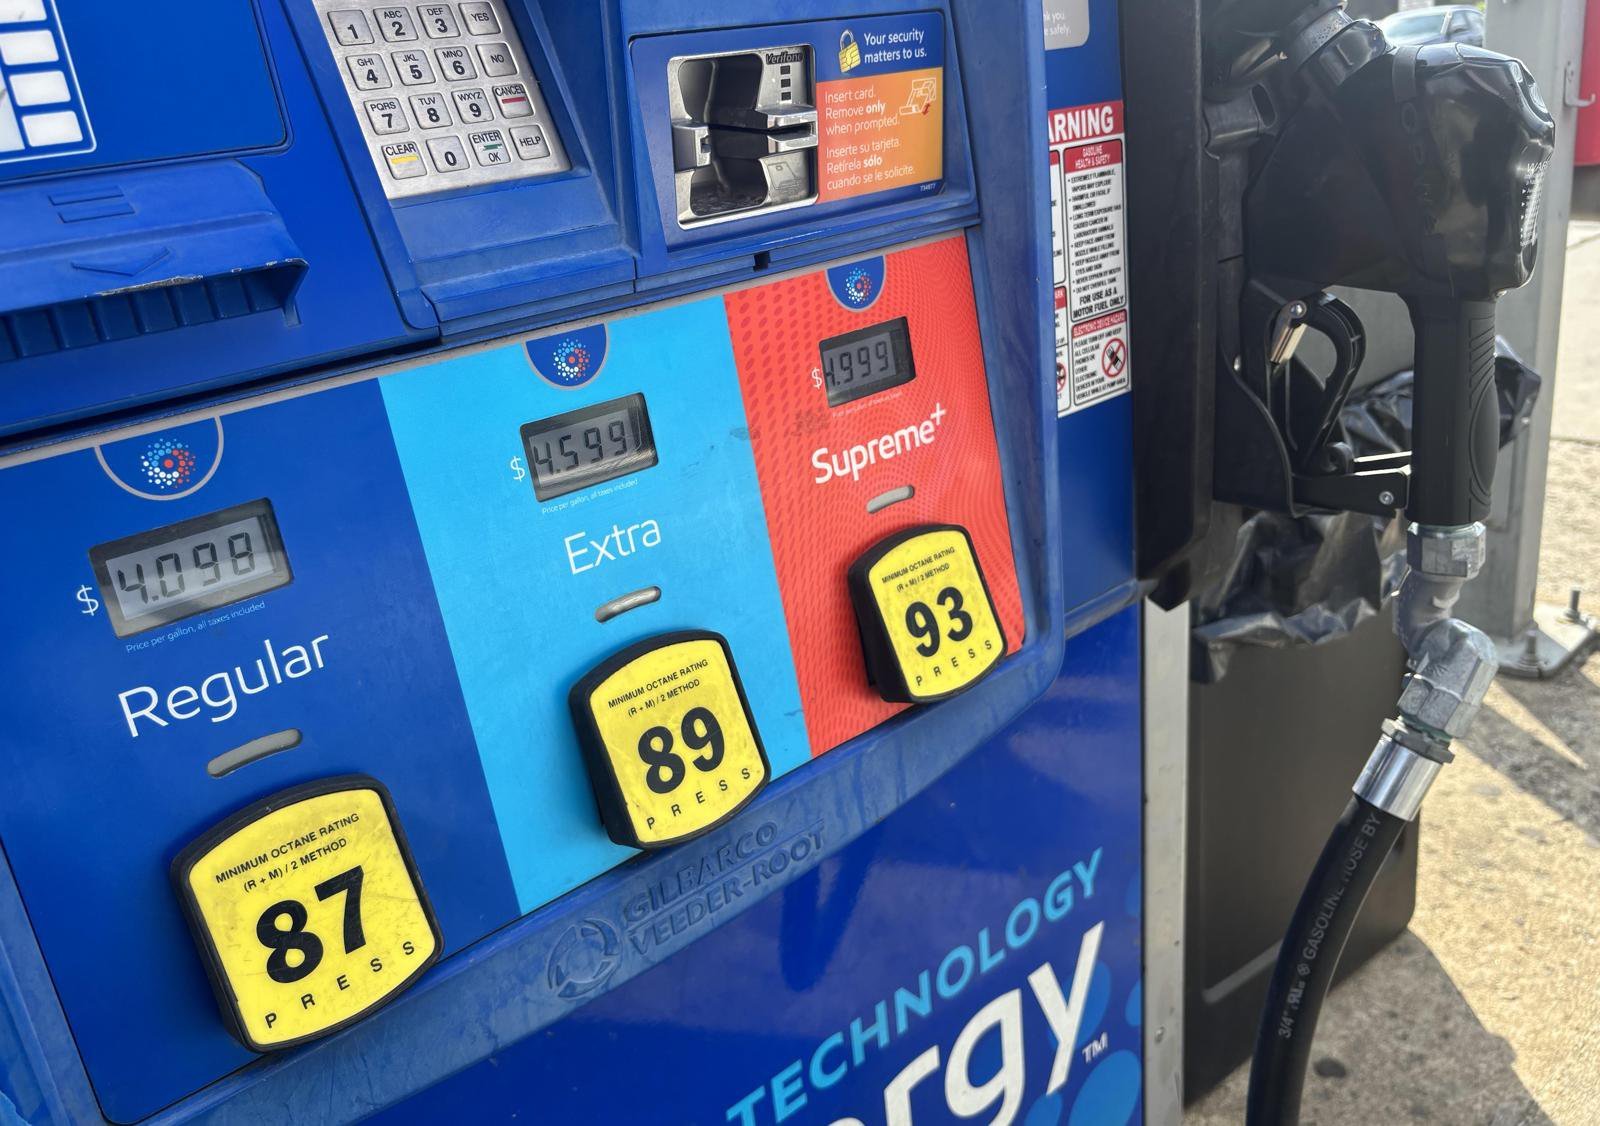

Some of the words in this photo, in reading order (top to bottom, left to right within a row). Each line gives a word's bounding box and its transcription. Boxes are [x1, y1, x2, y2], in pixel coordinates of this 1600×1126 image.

[384, 10, 402, 19] ABC
[427, 7, 443, 16] DEF
[471, 12, 489, 22] YES
[348, 24, 358, 39] 1
[392, 22, 405, 36] 2
[437, 19, 448, 33] 3
[864, 33, 885, 46] Your
[888, 28, 924, 44] security
[357, 57, 374, 67] GHI
[403, 53, 419, 62] JKL
[442, 50, 463, 59] MNO
[491, 54, 504, 63] NO
[865, 51, 900, 63] matters
[902, 47, 912, 58] to
[914, 47, 927, 58] us.
[366, 69, 378, 83] 4
[410, 65, 422, 79] 5
[454, 61, 465, 75] 6
[457, 91, 482, 101] WXYZ
[495, 84, 525, 97] CANCEL
[825, 91, 853, 104] Insert
[854, 87, 876, 101] card.
[370, 101, 396, 111] PQRS
[418, 97, 436, 105] TUV
[470, 103, 481, 117] 9
[825, 107, 864, 119] Remove
[866, 101, 886, 116] only
[381, 113, 394, 128] 7
[428, 108, 439, 122] 8
[825, 123, 852, 135] when
[854, 114, 899, 134] prompted.
[472, 132, 501, 144] ENTER
[519, 137, 541, 147] HELP
[385, 143, 416, 156] CLEAR
[826, 143, 857, 158] Inserte
[859, 143, 869, 152] su
[871, 137, 900, 151] tarjeta.
[445, 151, 457, 166] 0
[488, 153, 501, 162] OK
[863, 156, 882, 168] sólo
[827, 174, 861, 190] cuando
[863, 173, 873, 183] se
[875, 172, 882, 182] le
[884, 164, 915, 179] solicite.
[1080, 294, 1091, 306] FOR
[1092, 290, 1103, 301] USE
[1105, 288, 1112, 297] AS
[1073, 305, 1093, 318] MOTOR
[1094, 301, 1108, 311] FUEL
[1110, 295, 1123, 306] ONLY
[812, 367, 822, 389] $
[510, 456, 525, 482] $
[534, 420, 627, 475] 4.599
[564, 519, 661, 575] Extra
[882, 567, 908, 584] MINIMUM
[909, 557, 933, 572] OCTANE
[934, 546, 955, 561] RATING
[897, 584, 904, 593] (R
[909, 578, 917, 587] M)
[925, 563, 949, 579] METHOD
[76, 585, 99, 616] $
[126, 642, 149, 653] Price
[151, 635, 165, 647] per
[168, 625, 196, 642] gallon,
[198, 621, 206, 630] all
[208, 614, 230, 626] taxes
[232, 601, 265, 618] included
[905, 586, 973, 658] 93
[916, 640, 992, 686] PRESS
[118, 634, 328, 737] Regular
[608, 687, 645, 709] MINIMUM
[646, 672, 679, 692] OCTANE
[680, 659, 708, 676] RATING
[628, 707, 637, 718] (R
[645, 699, 655, 709] M)
[656, 696, 659, 704] /
[660, 694, 666, 703] 2
[667, 679, 700, 698] METHOD
[638, 707, 725, 794] 89
[647, 768, 750, 830] PRESS
[1362, 812, 1382, 837] BY
[215, 853, 269, 884] MINIMUM
[271, 832, 317, 859] OCTANE
[319, 813, 360, 837] RATING
[244, 879, 257, 893] (R
[260, 876, 267, 884] +
[269, 867, 283, 880] M)
[285, 864, 289, 874] /
[291, 861, 298, 871] 2
[300, 837, 347, 865] METHOD
[623, 821, 778, 924] GILBARCO
[629, 824, 825, 956] VEEDER-ROOT
[256, 865, 367, 984] 87
[265, 941, 415, 1029] PRESS
[725, 847, 1103, 1126] TECHNOLOGY
[827, 920, 1104, 1126] rgy
